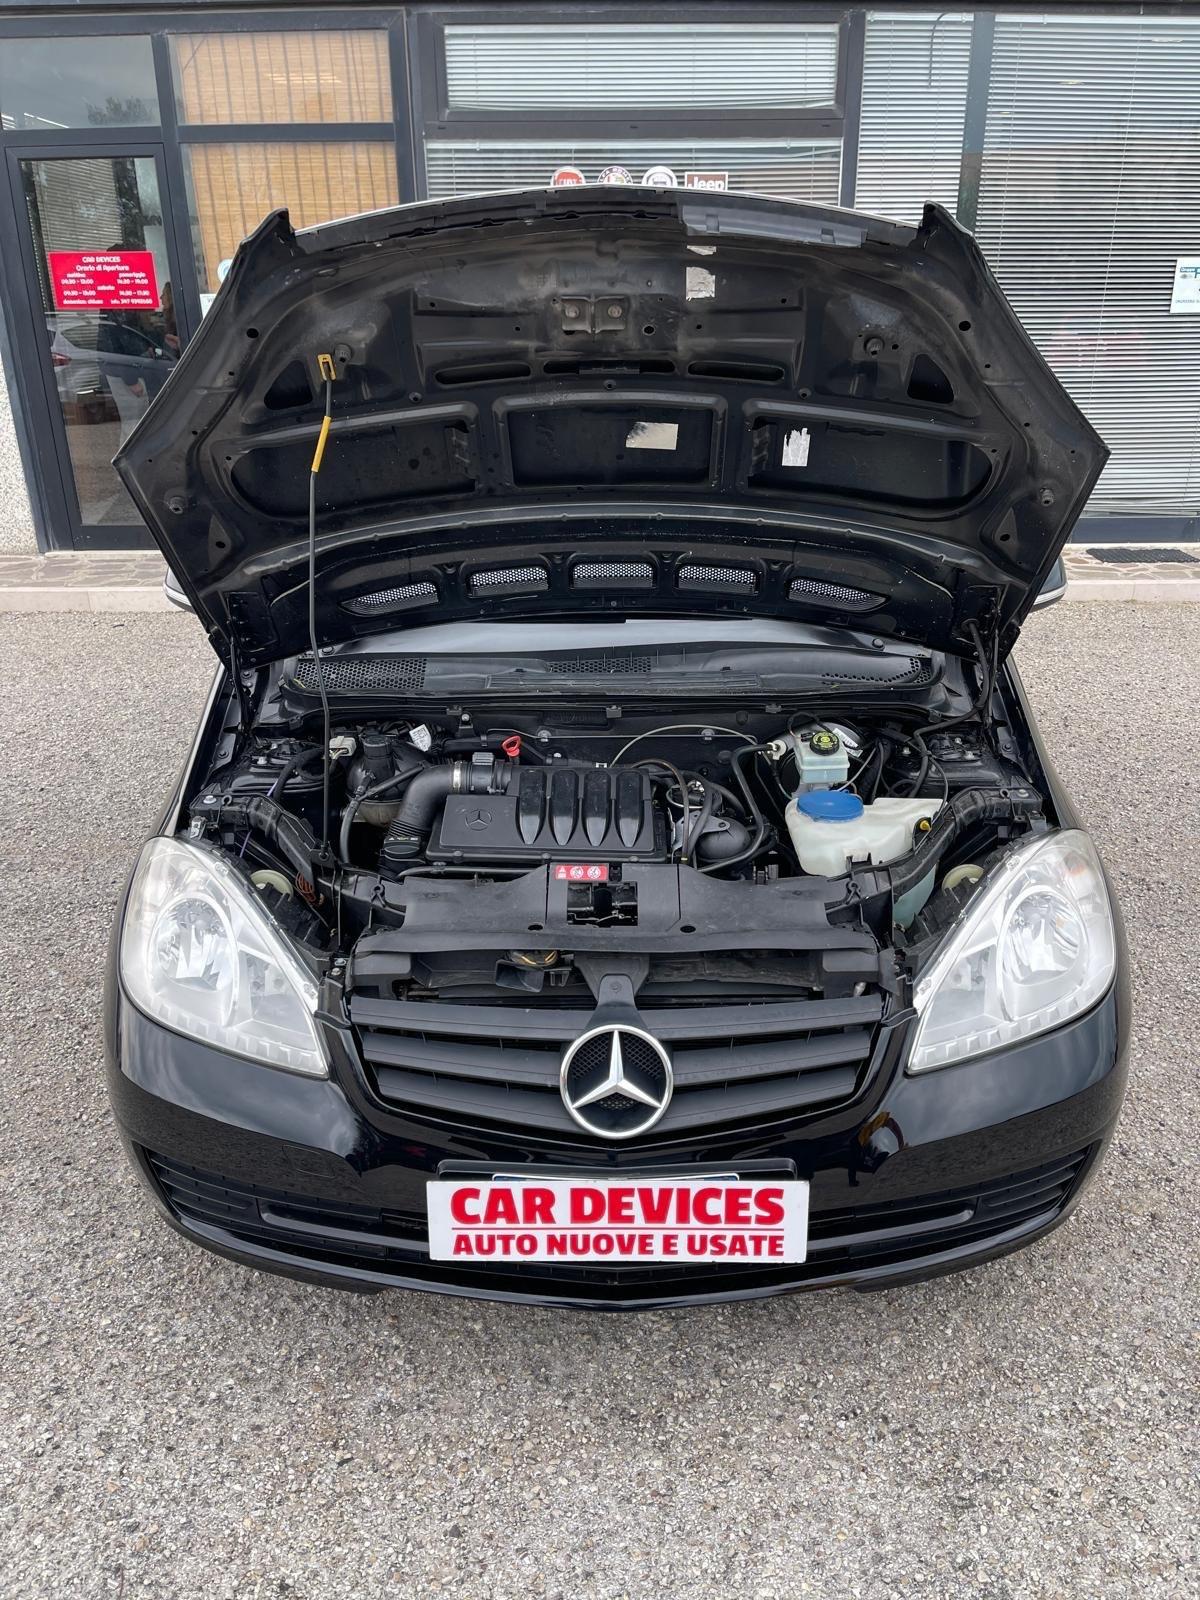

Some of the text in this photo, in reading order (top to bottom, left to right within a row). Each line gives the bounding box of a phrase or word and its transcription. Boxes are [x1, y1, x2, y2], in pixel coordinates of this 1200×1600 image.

[687, 176, 725, 191] Jeep
[451, 1187, 785, 1226] CAR DEVICES
[453, 1233, 785, 1257] AUTO NUOVE E USATE
